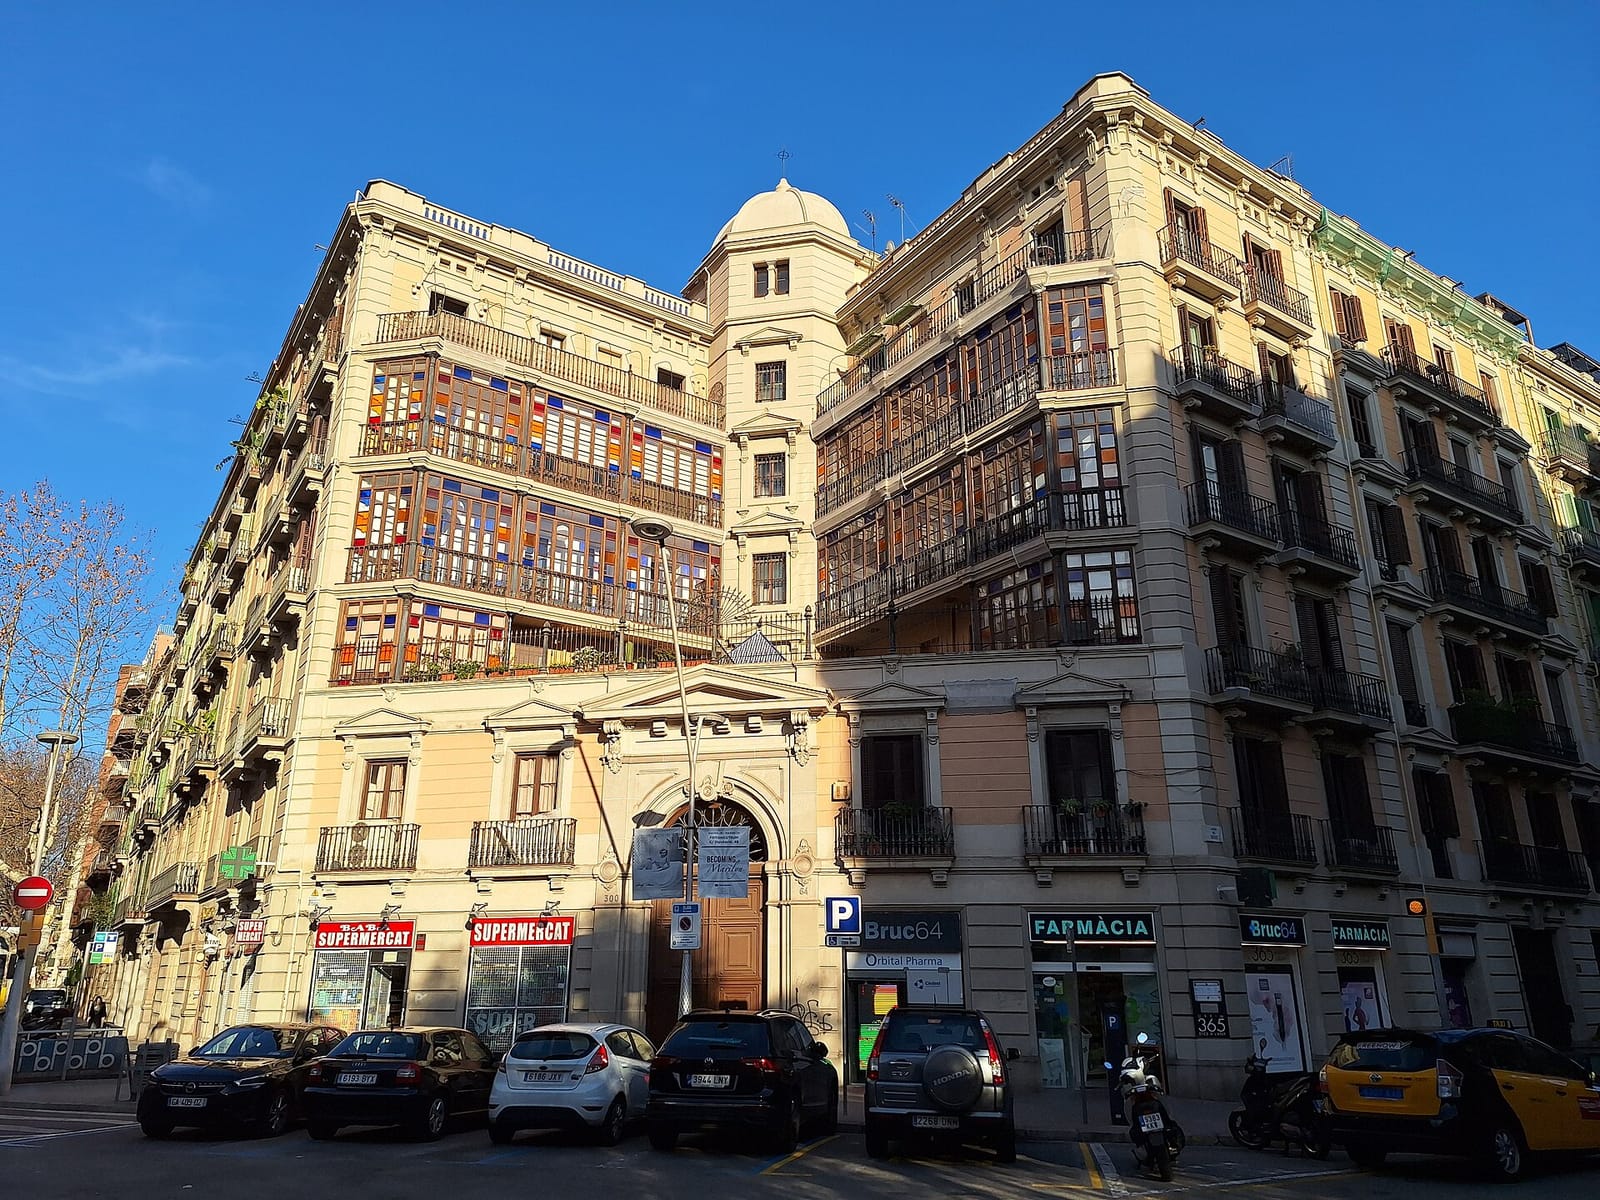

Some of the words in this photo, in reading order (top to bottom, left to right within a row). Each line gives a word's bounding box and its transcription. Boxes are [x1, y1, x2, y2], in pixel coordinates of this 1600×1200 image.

[604, 894, 619, 902] 300
[832, 900, 853, 929] P
[239, 921, 264, 931] SUPER
[473, 922, 571, 942] SUPERMERCAT
[865, 921, 943, 940] Bruc64
[1034, 915, 1149, 935] FARMÀCIA
[1250, 920, 1296, 939] Bruc64
[237, 931, 262, 942] MERCAT
[318, 931, 411, 947] SUPERMERCAT
[1333, 924, 1388, 942] FARMÀCIA
[95, 943, 104, 952] P
[866, 953, 903, 967] Orbital
[906, 957, 943, 966] Pharma
[1109, 1016, 1117, 1028] P
[1198, 1018, 1226, 1032] 365
[693, 1075, 711, 1084] 3944
[713, 1076, 729, 1085] LNY
[932, 1069, 970, 1087] HONDA
[918, 1116, 938, 1126] 2268
